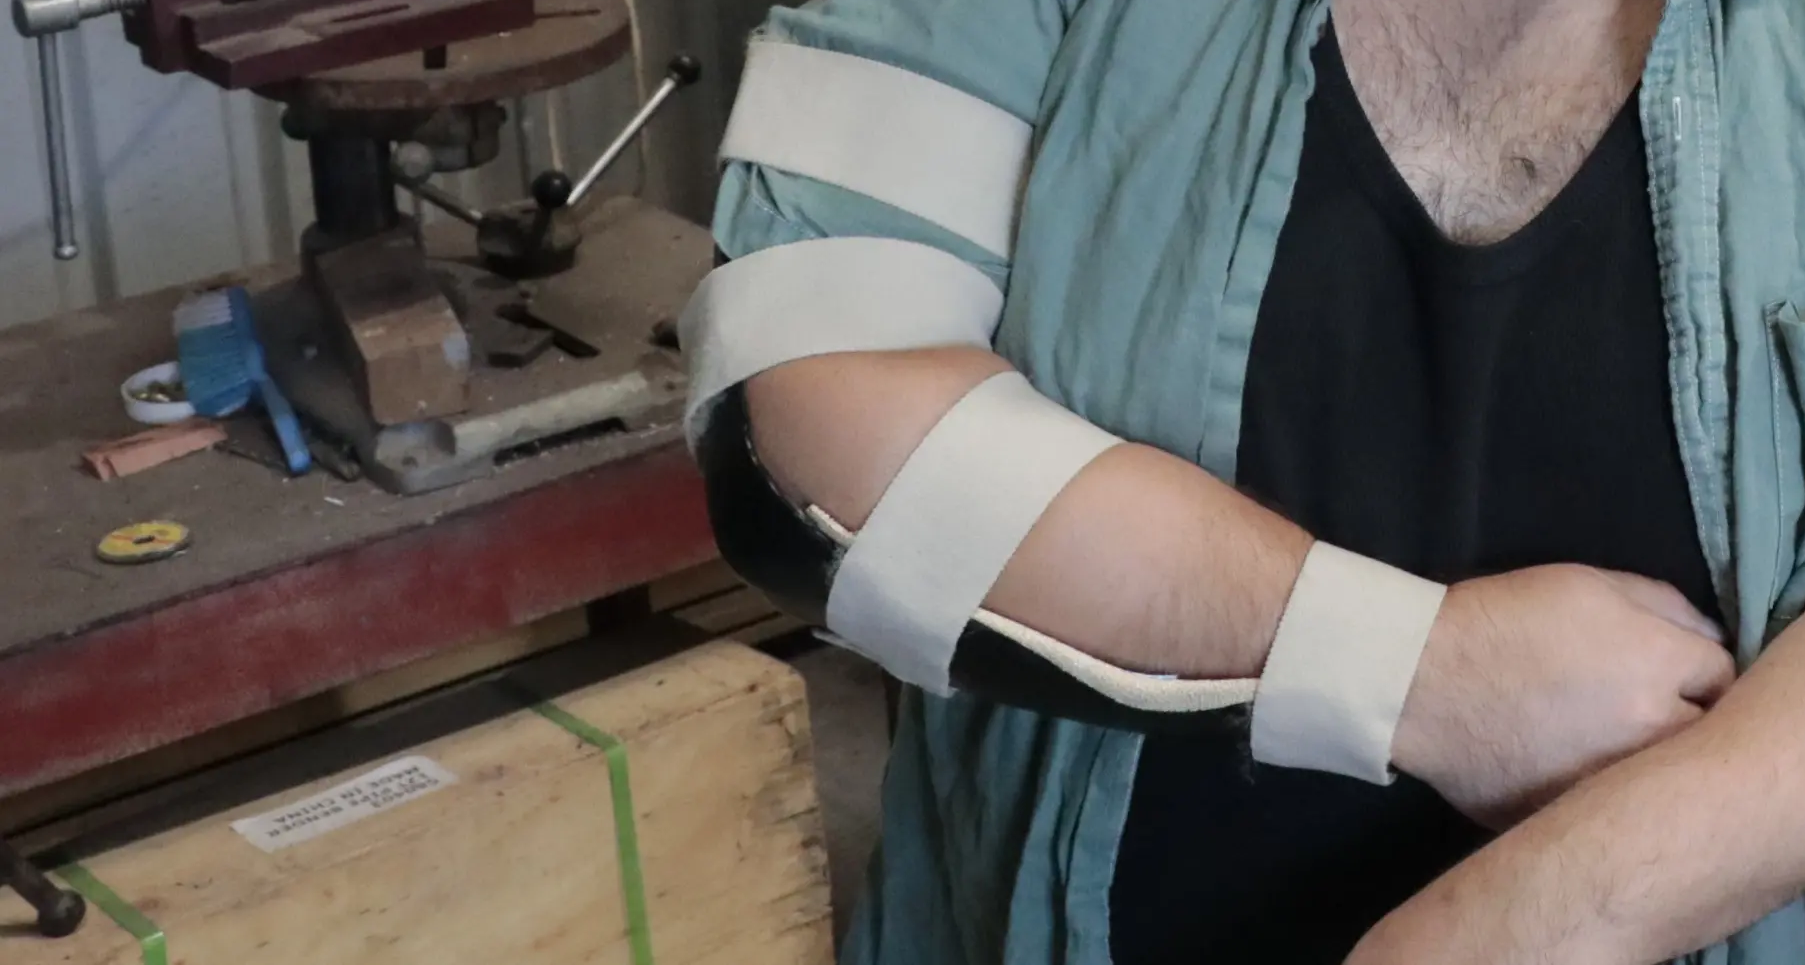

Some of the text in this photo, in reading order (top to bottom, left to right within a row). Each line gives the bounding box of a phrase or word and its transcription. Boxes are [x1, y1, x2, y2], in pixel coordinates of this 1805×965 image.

[272, 765, 420, 823] MADE IN CHINA
[349, 788, 392, 807] PIPE
[266, 806, 344, 837] BENDER
